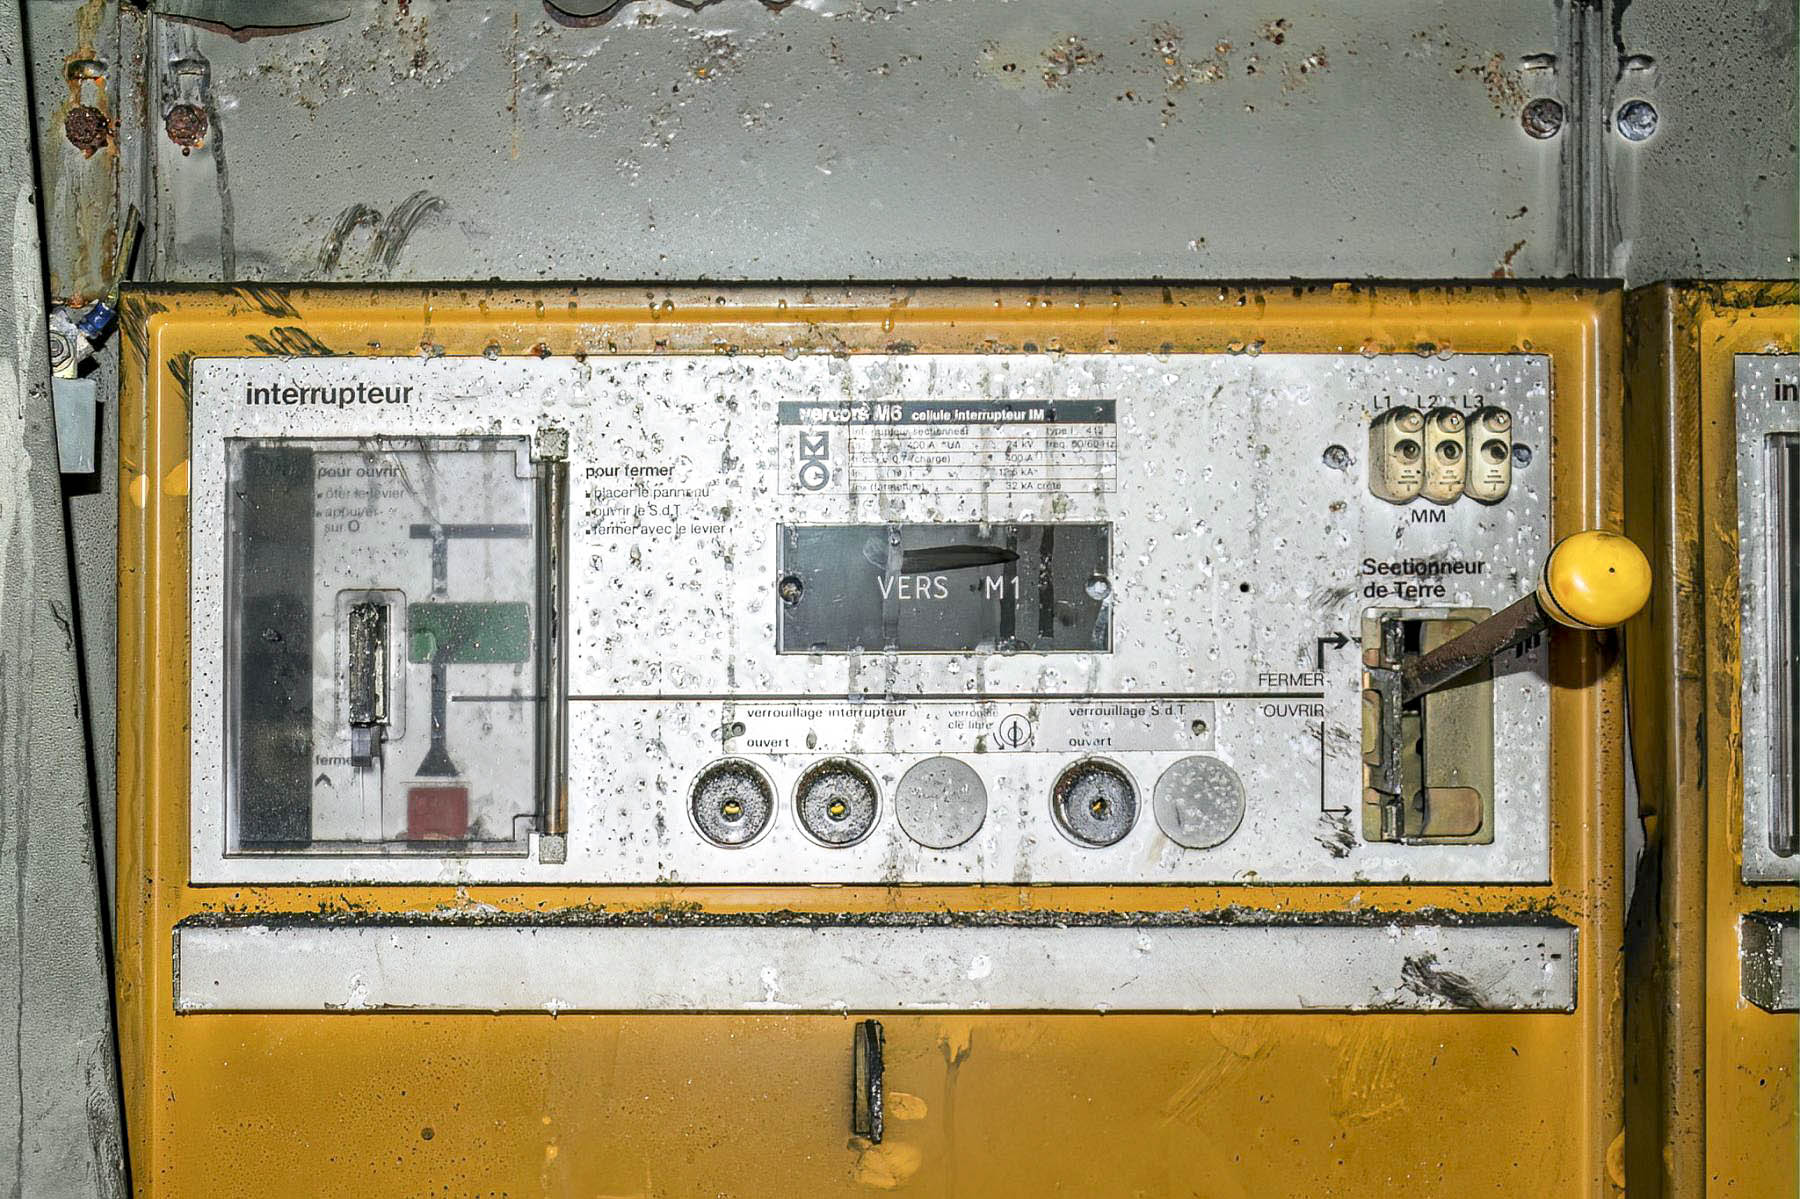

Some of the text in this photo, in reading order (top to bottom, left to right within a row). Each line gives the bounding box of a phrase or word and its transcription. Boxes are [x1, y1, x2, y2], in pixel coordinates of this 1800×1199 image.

[246, 382, 413, 409] interrupteur
[1373, 395, 1391, 409] L1
[1417, 395, 1438, 409] L2
[1463, 395, 1484, 409] L3
[874, 404, 903, 421] M6
[912, 408, 1045, 422] cellule interrupteur IM
[318, 465, 401, 480] pour ouvrir
[586, 464, 676, 479] pour fermer
[594, 487, 634, 500] placer
[638, 486, 649, 498] le
[594, 506, 630, 517] ouvrir
[634, 504, 646, 517] le
[1411, 509, 1446, 523] MM
[593, 524, 726, 536] fermer avec le levier
[1361, 557, 1486, 576] Sectionneur
[877, 575, 1020, 600] VERS M1
[1363, 581, 1446, 598] de Terre
[1258, 672, 1325, 687] FERMER
[747, 706, 908, 720] verrouillage interrupteur
[1069, 704, 1146, 719] verrouillage
[1263, 703, 1325, 718] OUVRIR
[747, 738, 790, 749] ouvert
[1069, 738, 1112, 747] ouvert
